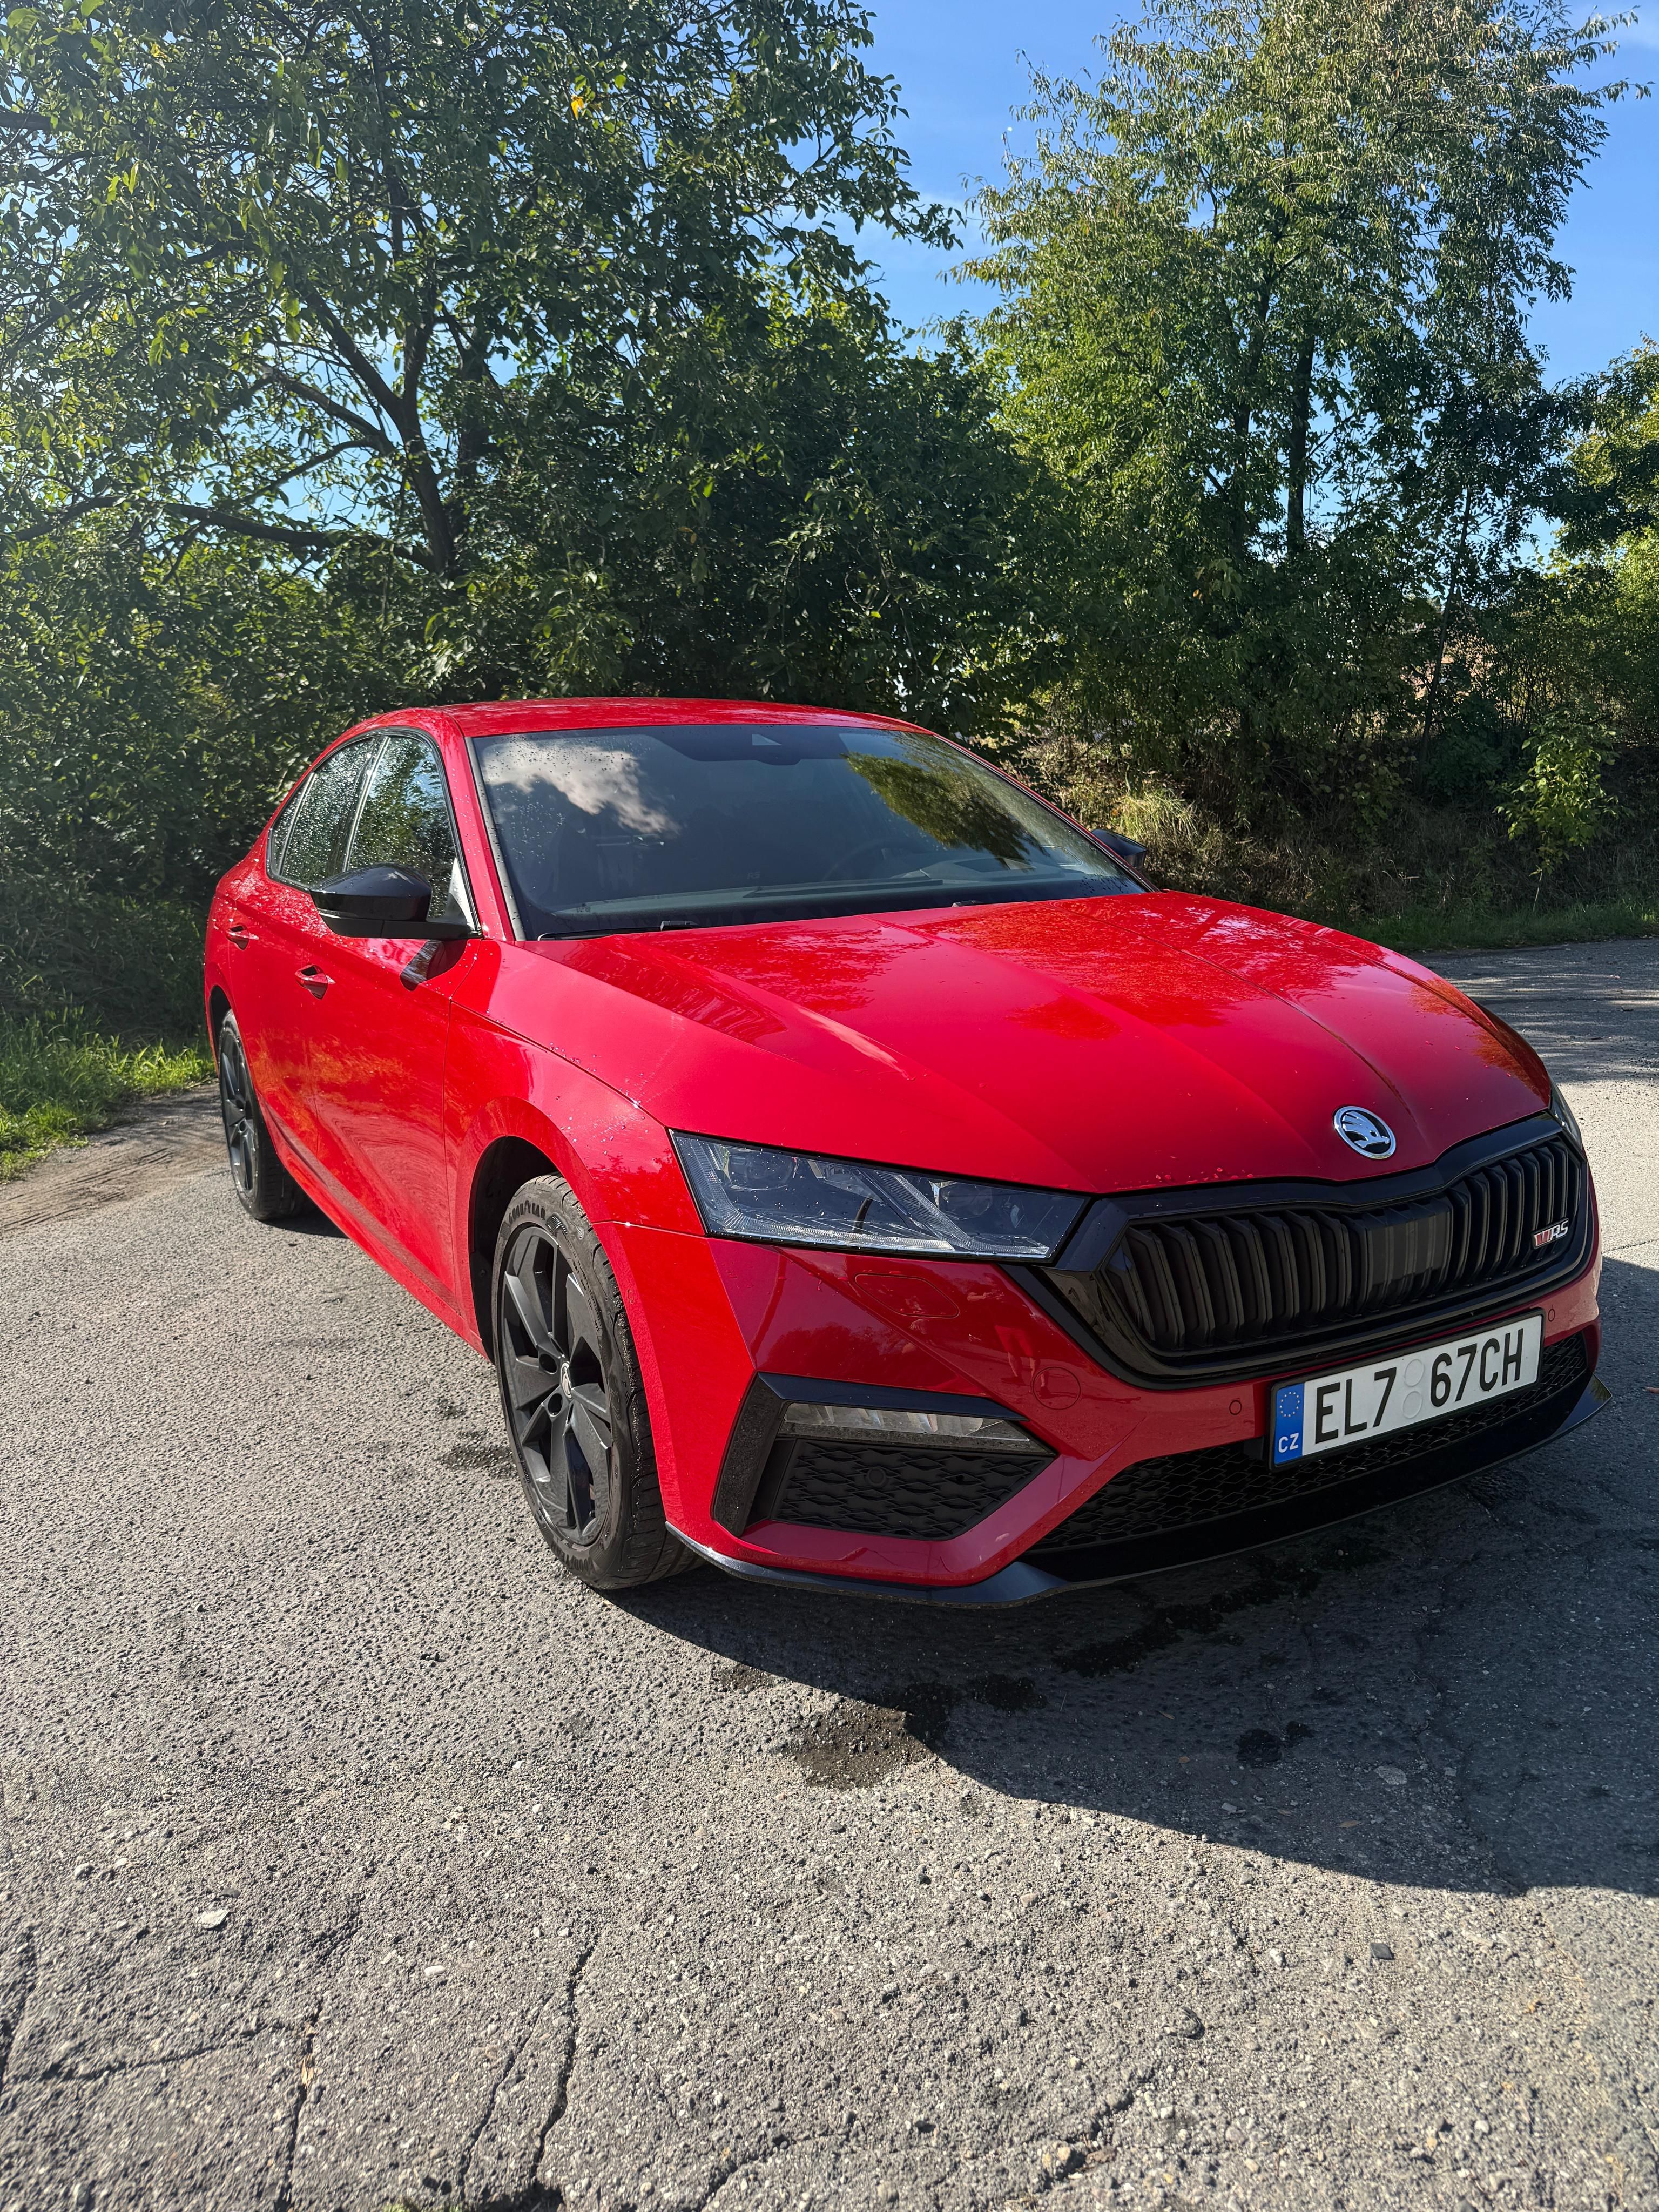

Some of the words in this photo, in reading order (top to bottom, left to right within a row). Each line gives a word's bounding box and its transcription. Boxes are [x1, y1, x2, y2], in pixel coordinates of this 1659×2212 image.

[509, 1199, 545, 1224] GOODYEAR
[1314, 1366, 1397, 1444] EL7
[1429, 1328, 1523, 1408] 67CH
[1278, 1432, 1299, 1453] CZ
